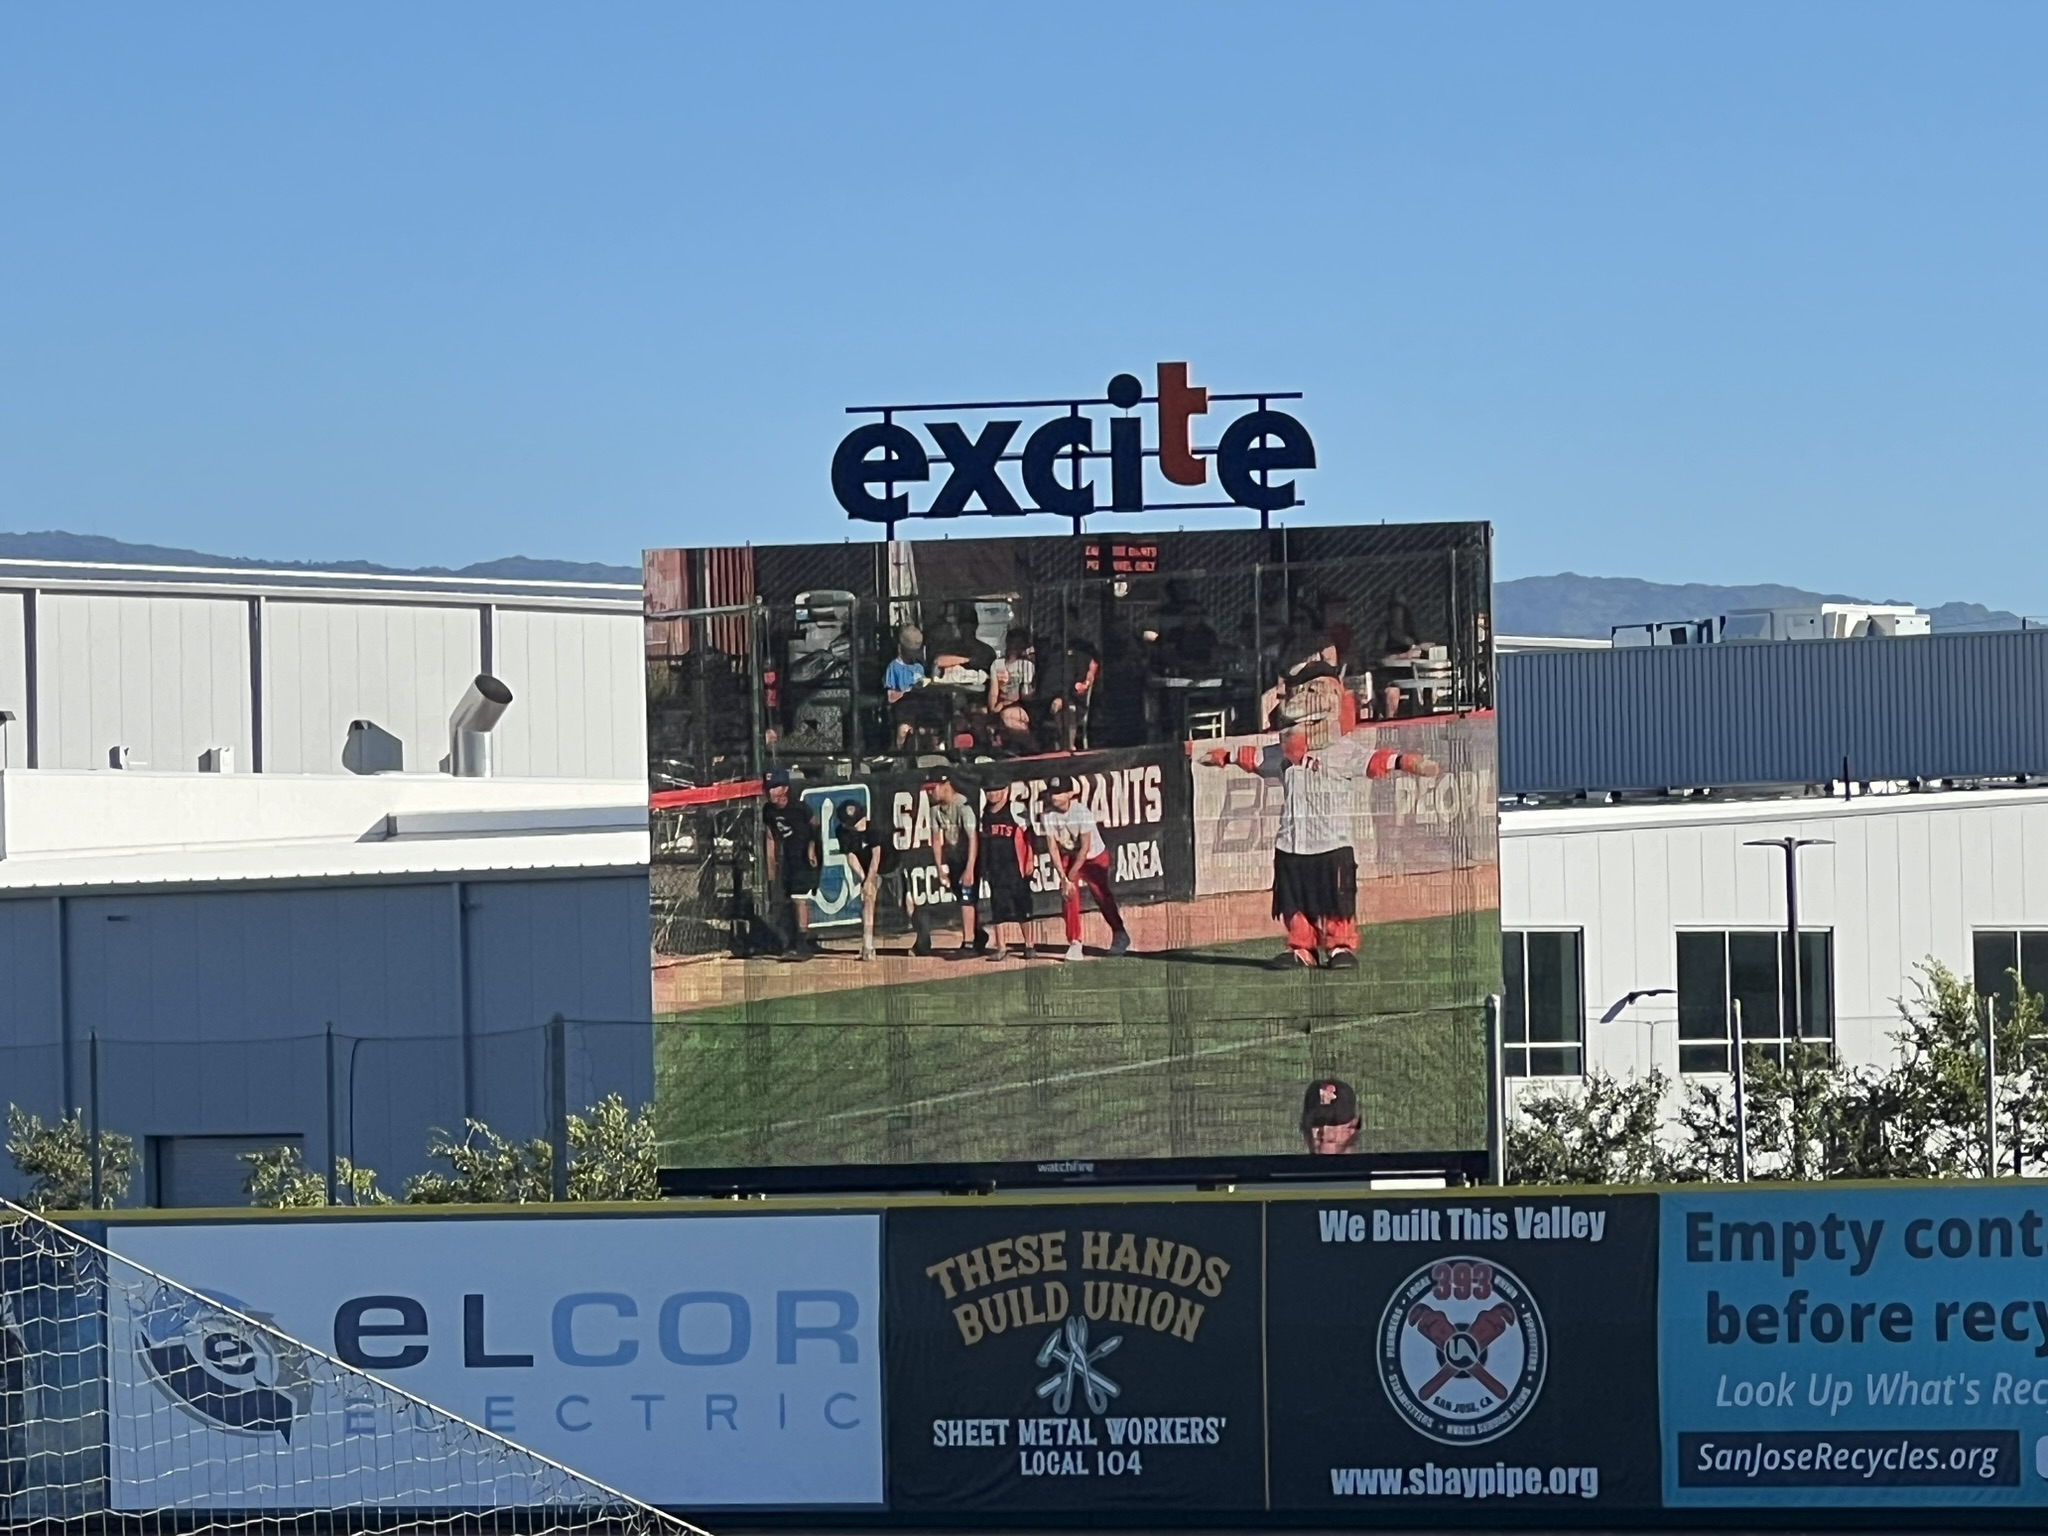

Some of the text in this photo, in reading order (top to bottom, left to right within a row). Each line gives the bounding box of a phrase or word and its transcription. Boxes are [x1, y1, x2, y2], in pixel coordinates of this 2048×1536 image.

[831, 361, 1317, 522] excite
[1115, 840, 1164, 883] AREA
[1319, 1206, 1606, 1242] We Built This Valley
[1686, 1209, 2048, 1277] Empty cont
[927, 1230, 1231, 1300] THESE HANDS
[1432, 1263, 1492, 1300] 393
[952, 1280, 1206, 1346] BUILD UNION
[1707, 1290, 1913, 1344] before
[344, 1392, 862, 1434] ELECTRIC
[1716, 1370, 2048, 1416] Look Up What's Rec
[933, 1417, 1227, 1448] SHEET METAL WORKERS'
[1020, 1450, 1143, 1477] LOCAL 104
[1697, 1440, 1999, 1478] SanJoseRecycles.org
[1331, 1462, 1599, 1500] www.sbaypipe.org
